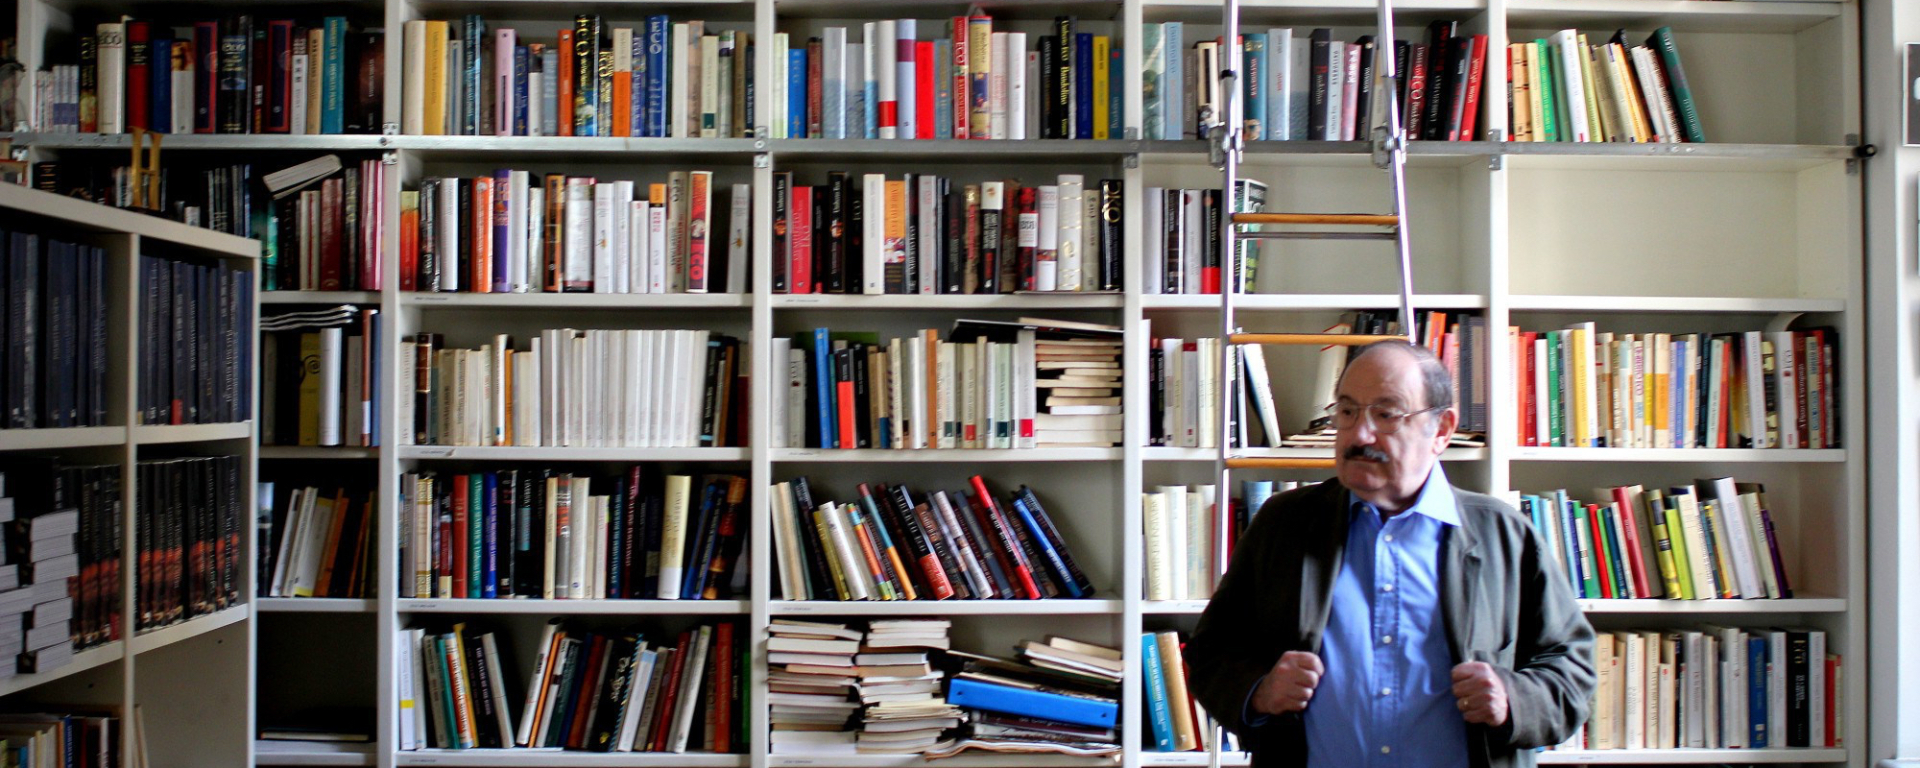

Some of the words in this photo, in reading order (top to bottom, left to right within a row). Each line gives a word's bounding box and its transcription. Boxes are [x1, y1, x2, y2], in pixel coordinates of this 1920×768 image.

[649, 21, 662, 54] ECO
[956, 41, 964, 63] ECO
[1059, 66, 1069, 104] Baudolino
[1410, 74, 1425, 99] ECO
[893, 488, 918, 534] UMBERTO
[913, 534, 927, 552] ECO
